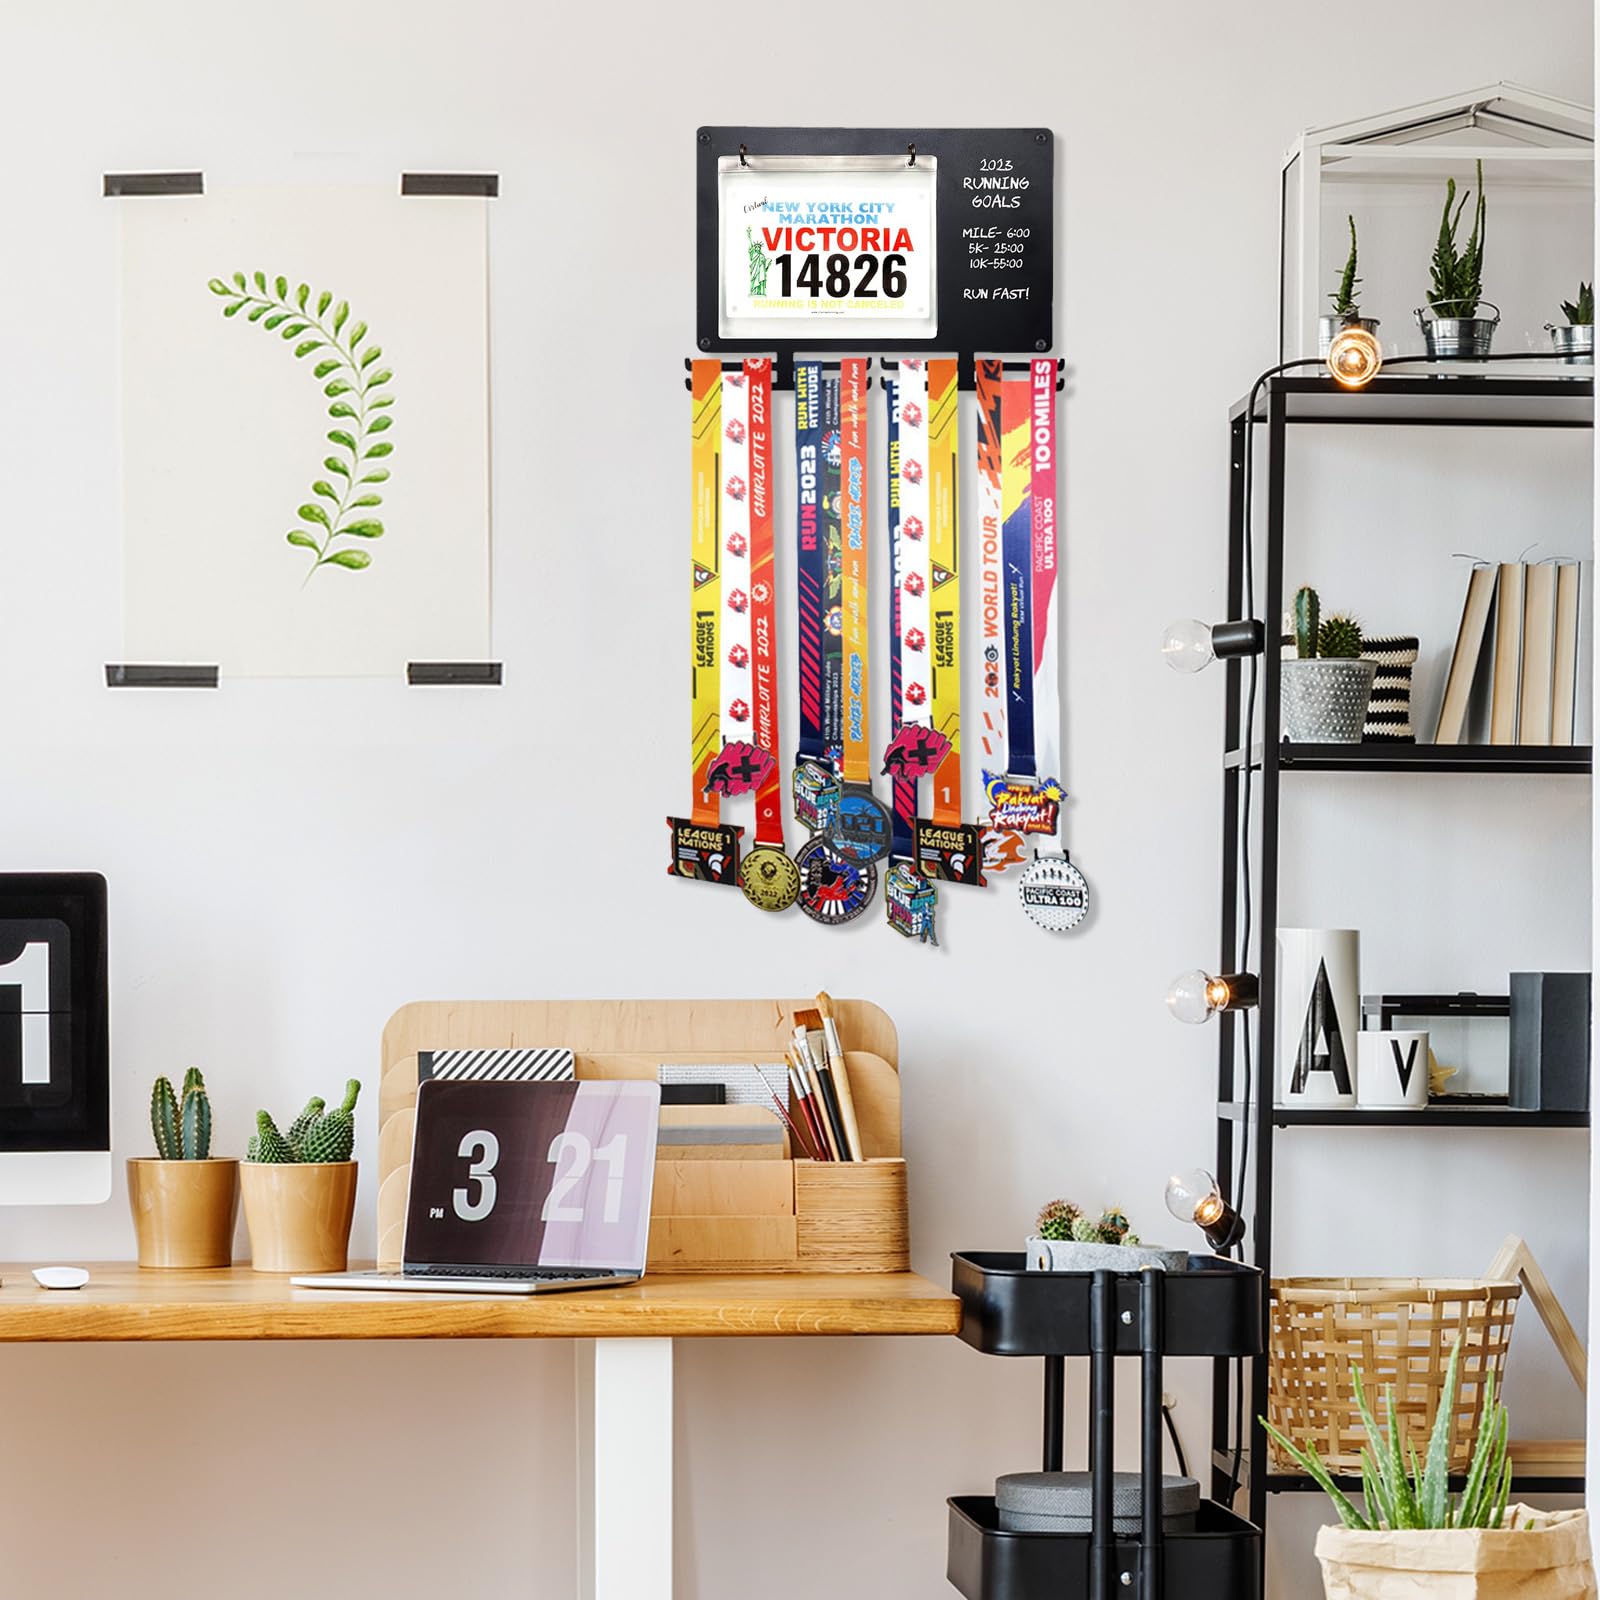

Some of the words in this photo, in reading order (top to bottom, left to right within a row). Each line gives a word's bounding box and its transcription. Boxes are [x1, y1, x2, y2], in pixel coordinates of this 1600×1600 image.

[980, 159, 1013, 171] 2023
[963, 176, 1030, 190] RUNNING
[762, 202, 804, 213] NEW
[806, 202, 853, 213] YORK
[859, 202, 895, 213] CITY
[972, 194, 1021, 208] GOALS
[779, 214, 878, 224] MARATHON
[962, 226, 1002, 239] MILE-
[1006, 228, 1030, 238] 6:00
[761, 227, 914, 251] VICTORIA
[968, 243, 989, 254] 5K-
[994, 243, 1024, 254] 25:00
[775, 254, 907, 298] 14826
[753, 300, 804, 309] RUNNING
[808, 300, 817, 309] IS
[821, 300, 845, 309] NOT
[848, 300, 904, 309] CANCELED
[963, 288, 988, 300] RUN
[993, 287, 1030, 300] FAST!
[798, 367, 807, 399] WITH
[808, 365, 818, 428] ATTITUDE
[752, 382, 765, 425] 2022
[798, 401, 808, 430] RUN
[1035, 360, 1051, 472] 100MILES
[753, 431, 766, 518] CHARLOTTE
[1034, 496, 1043, 530] COAST
[1043, 498, 1053, 523] 100
[983, 515, 997, 565] TOUR
[1034, 532, 1044, 572] PACIFIC
[1043, 525, 1054, 569] ULTRA
[984, 570, 998, 638] WORLD
[696, 622, 706, 667] LEAGUE
[705, 621, 715, 667] NATIONS
[756, 615, 769, 657] 2022
[935, 622, 945, 667] LEAGUE
[944, 621, 954, 667] NATIONS
[1011, 620, 1021, 656] Lindung
[1012, 657, 1021, 689] Rakyat
[757, 665, 771, 749] CHARLOTTE
[678, 828, 723, 843] LEAGUE
[725, 835, 731, 844] 1
[678, 838, 724, 852] NATIONS
[920, 828, 965, 843] LEAGUE
[967, 834, 973, 844] 1
[920, 837, 965, 851] NATIONS
[1026, 888, 1054, 896] PACIFIC
[1055, 889, 1080, 898] COAST
[1026, 895, 1057, 905] ULTRA
[1059, 897, 1081, 906] 100
[1290, 955, 1353, 1095] A
[1390, 1039, 1419, 1098] V
[429, 1207, 444, 1218] PM
[452, 1130, 500, 1221] 3
[541, 1131, 628, 1223] 21
